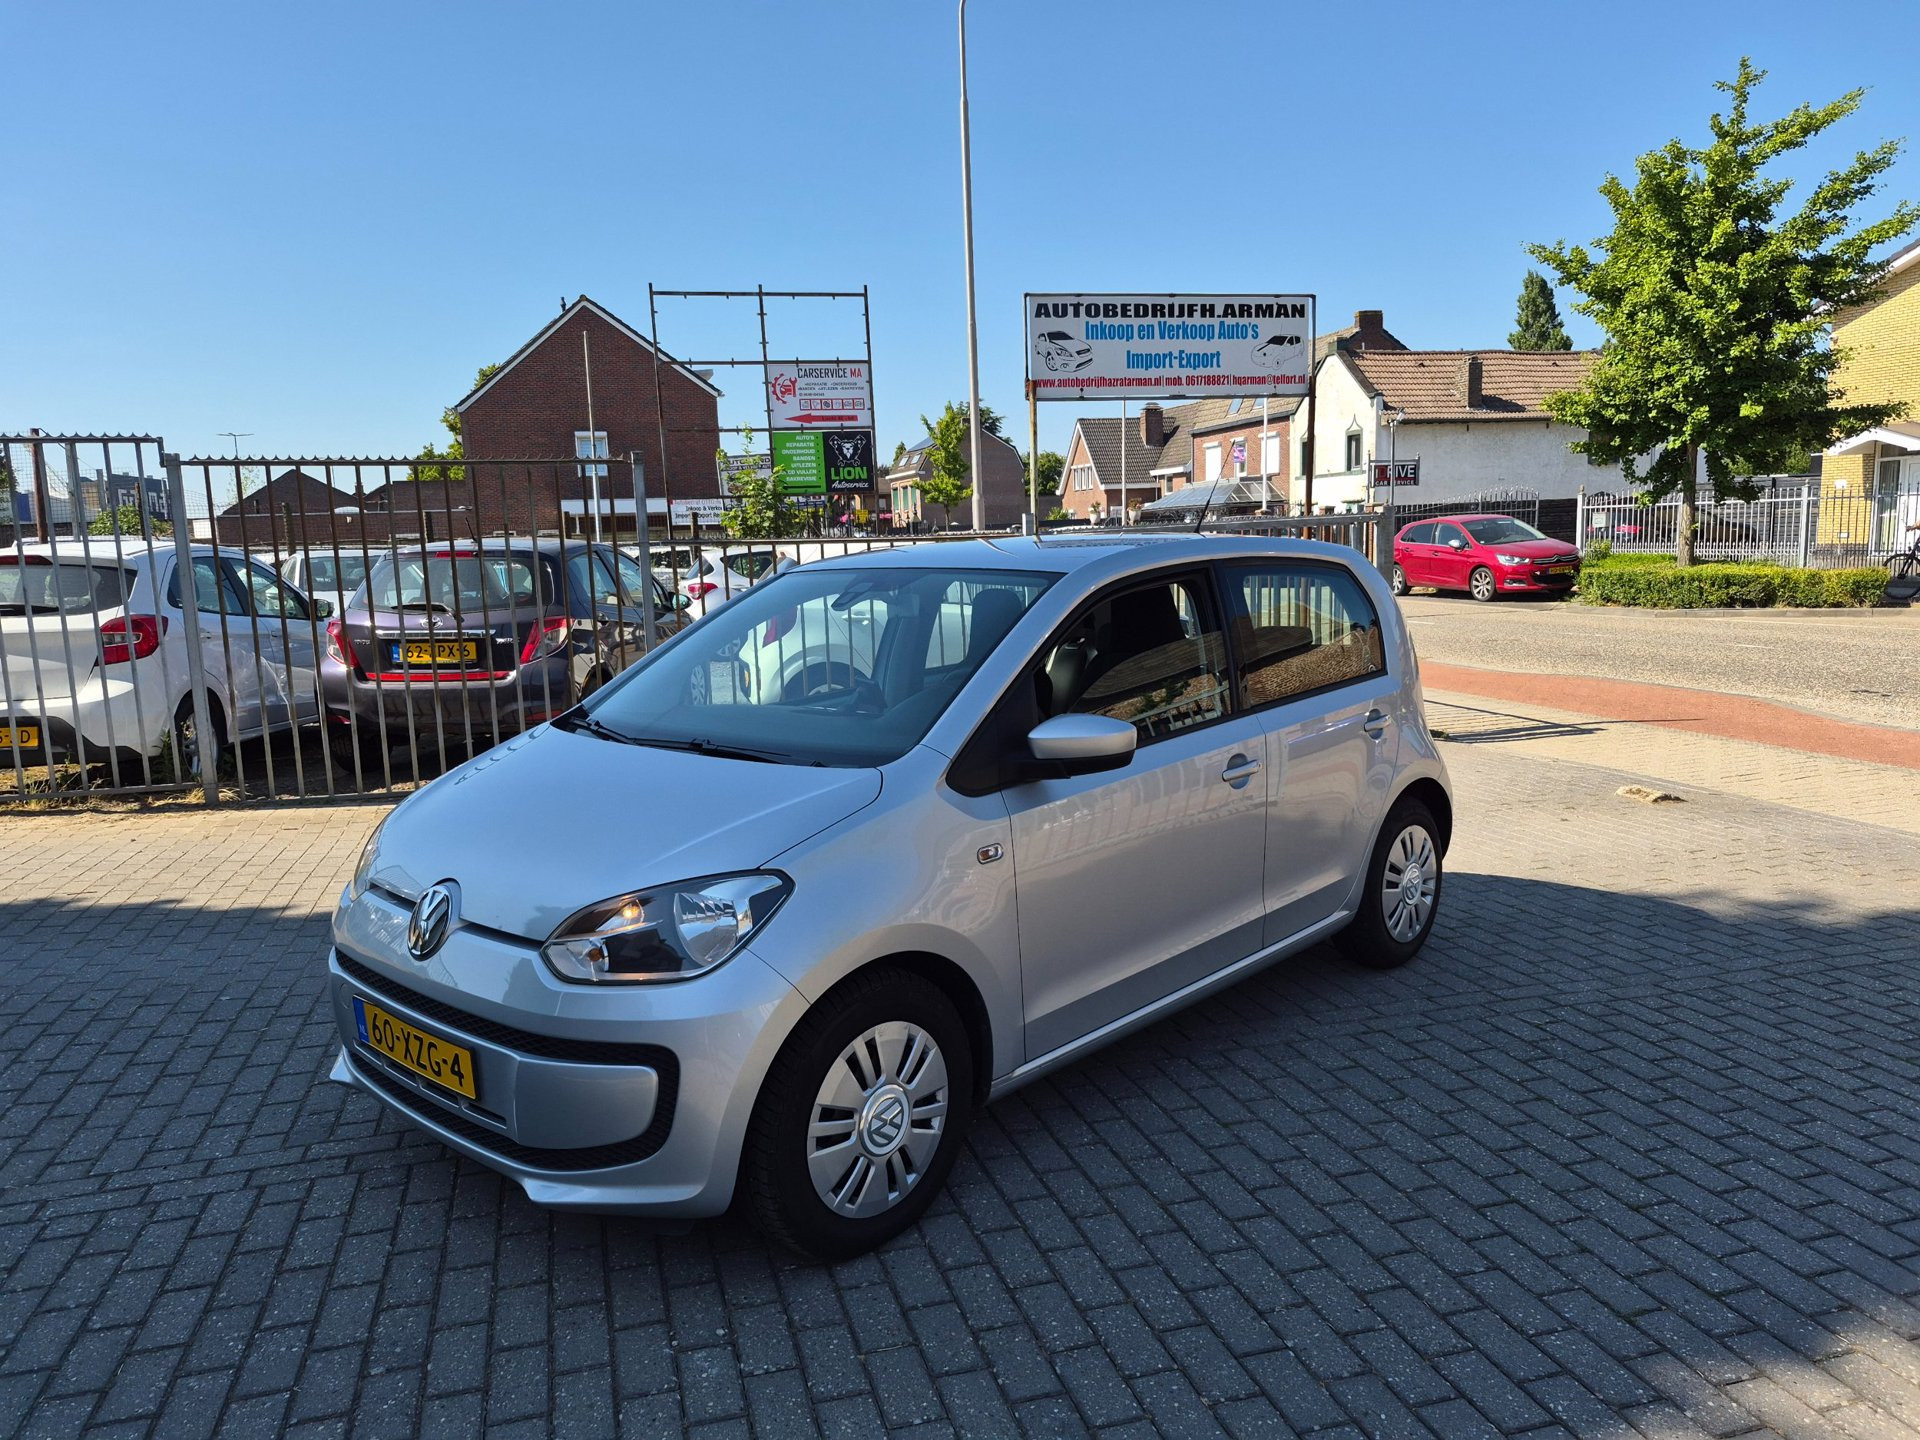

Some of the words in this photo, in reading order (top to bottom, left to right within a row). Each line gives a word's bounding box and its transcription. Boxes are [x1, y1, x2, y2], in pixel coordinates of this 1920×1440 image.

[1034, 302, 1306, 319] AUTOBEDRIJFH.ARMAN
[1085, 321, 1133, 341] Inkoop
[1138, 324, 1155, 339] en
[1158, 321, 1216, 341] Verkoop
[1218, 320, 1259, 339] Auto's
[1126, 350, 1222, 370] Import-Export
[798, 367, 848, 379] CARSERVICE
[850, 367, 862, 378] MA
[1165, 375, 1184, 386] mob.
[830, 467, 868, 480] LION
[831, 480, 869, 489] Autoservice
[371, 1012, 465, 1088] 60-XZG-4
